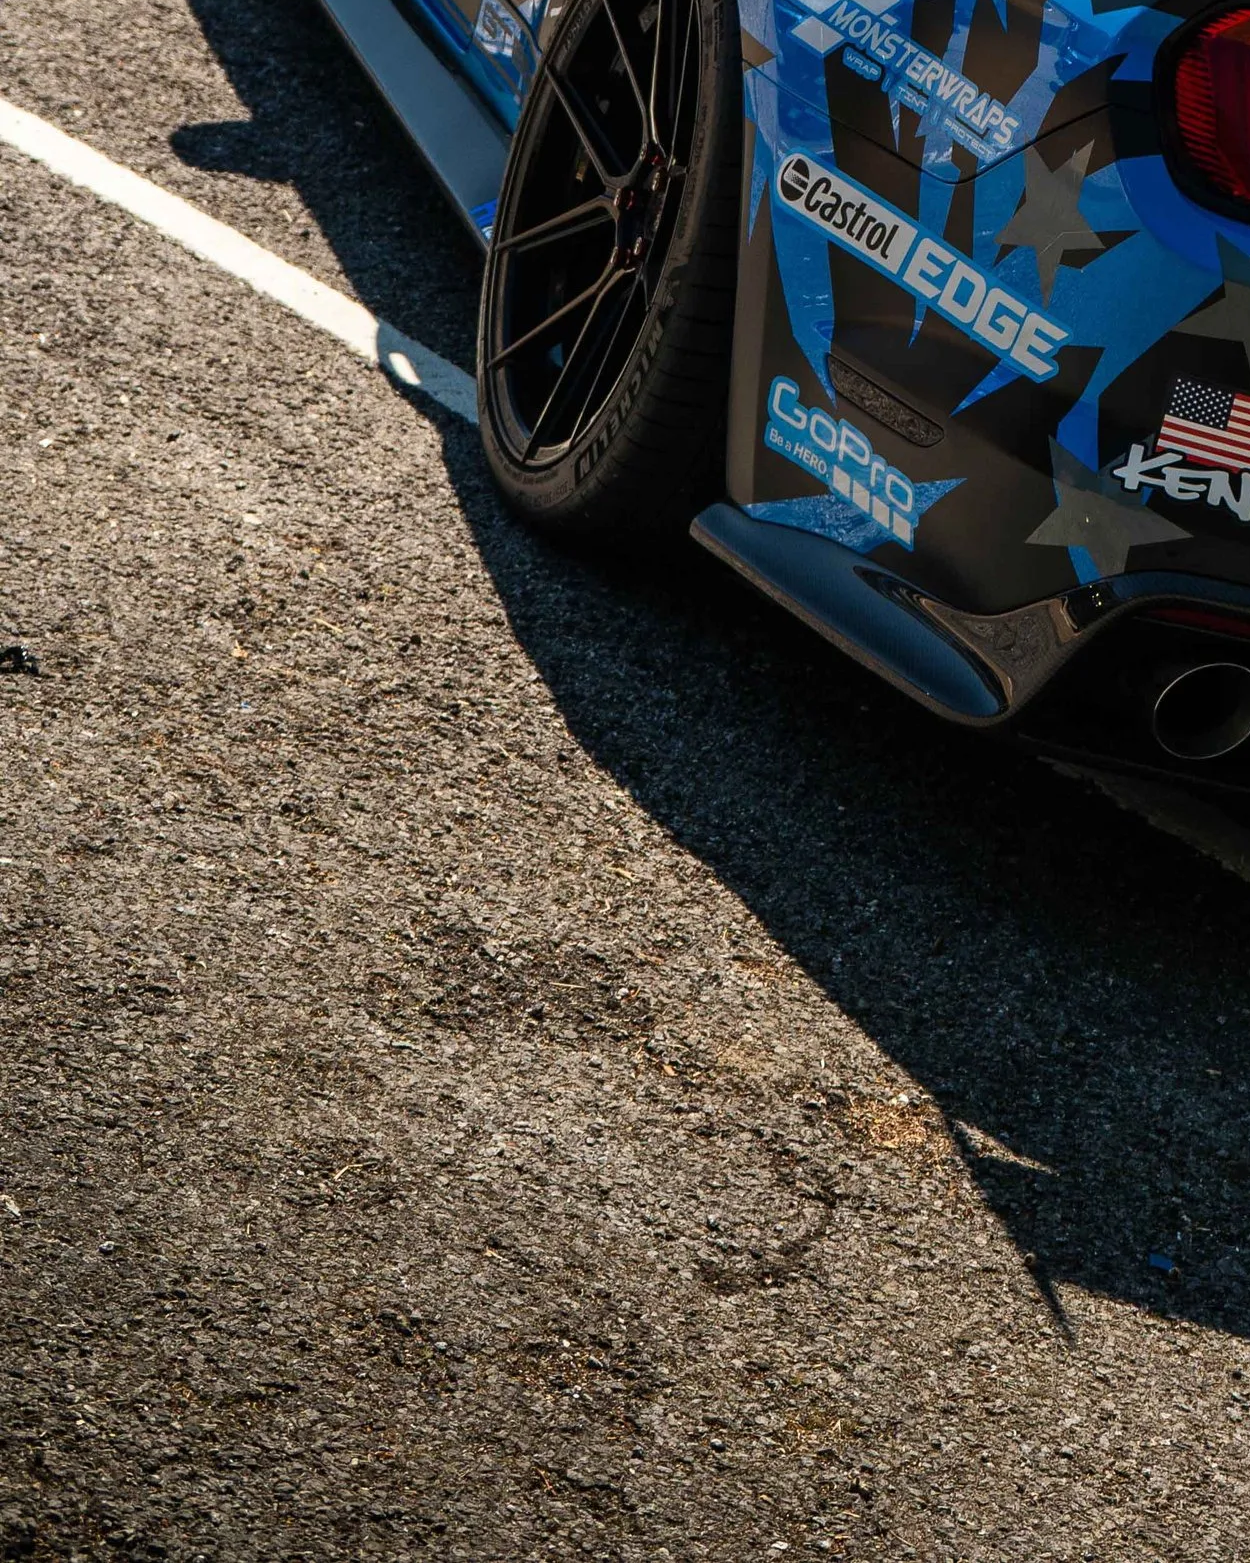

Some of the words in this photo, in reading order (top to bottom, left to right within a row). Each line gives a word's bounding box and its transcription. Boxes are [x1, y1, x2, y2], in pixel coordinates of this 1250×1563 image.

[845, 51, 881, 80] WRAP
[897, 86, 928, 111] TINT
[943, 118, 994, 158] PROTECT
[804, 176, 902, 261] Castrol
[902, 236, 1069, 375] EDGE
[768, 426, 785, 445] Be
[771, 381, 914, 514] GoPro
